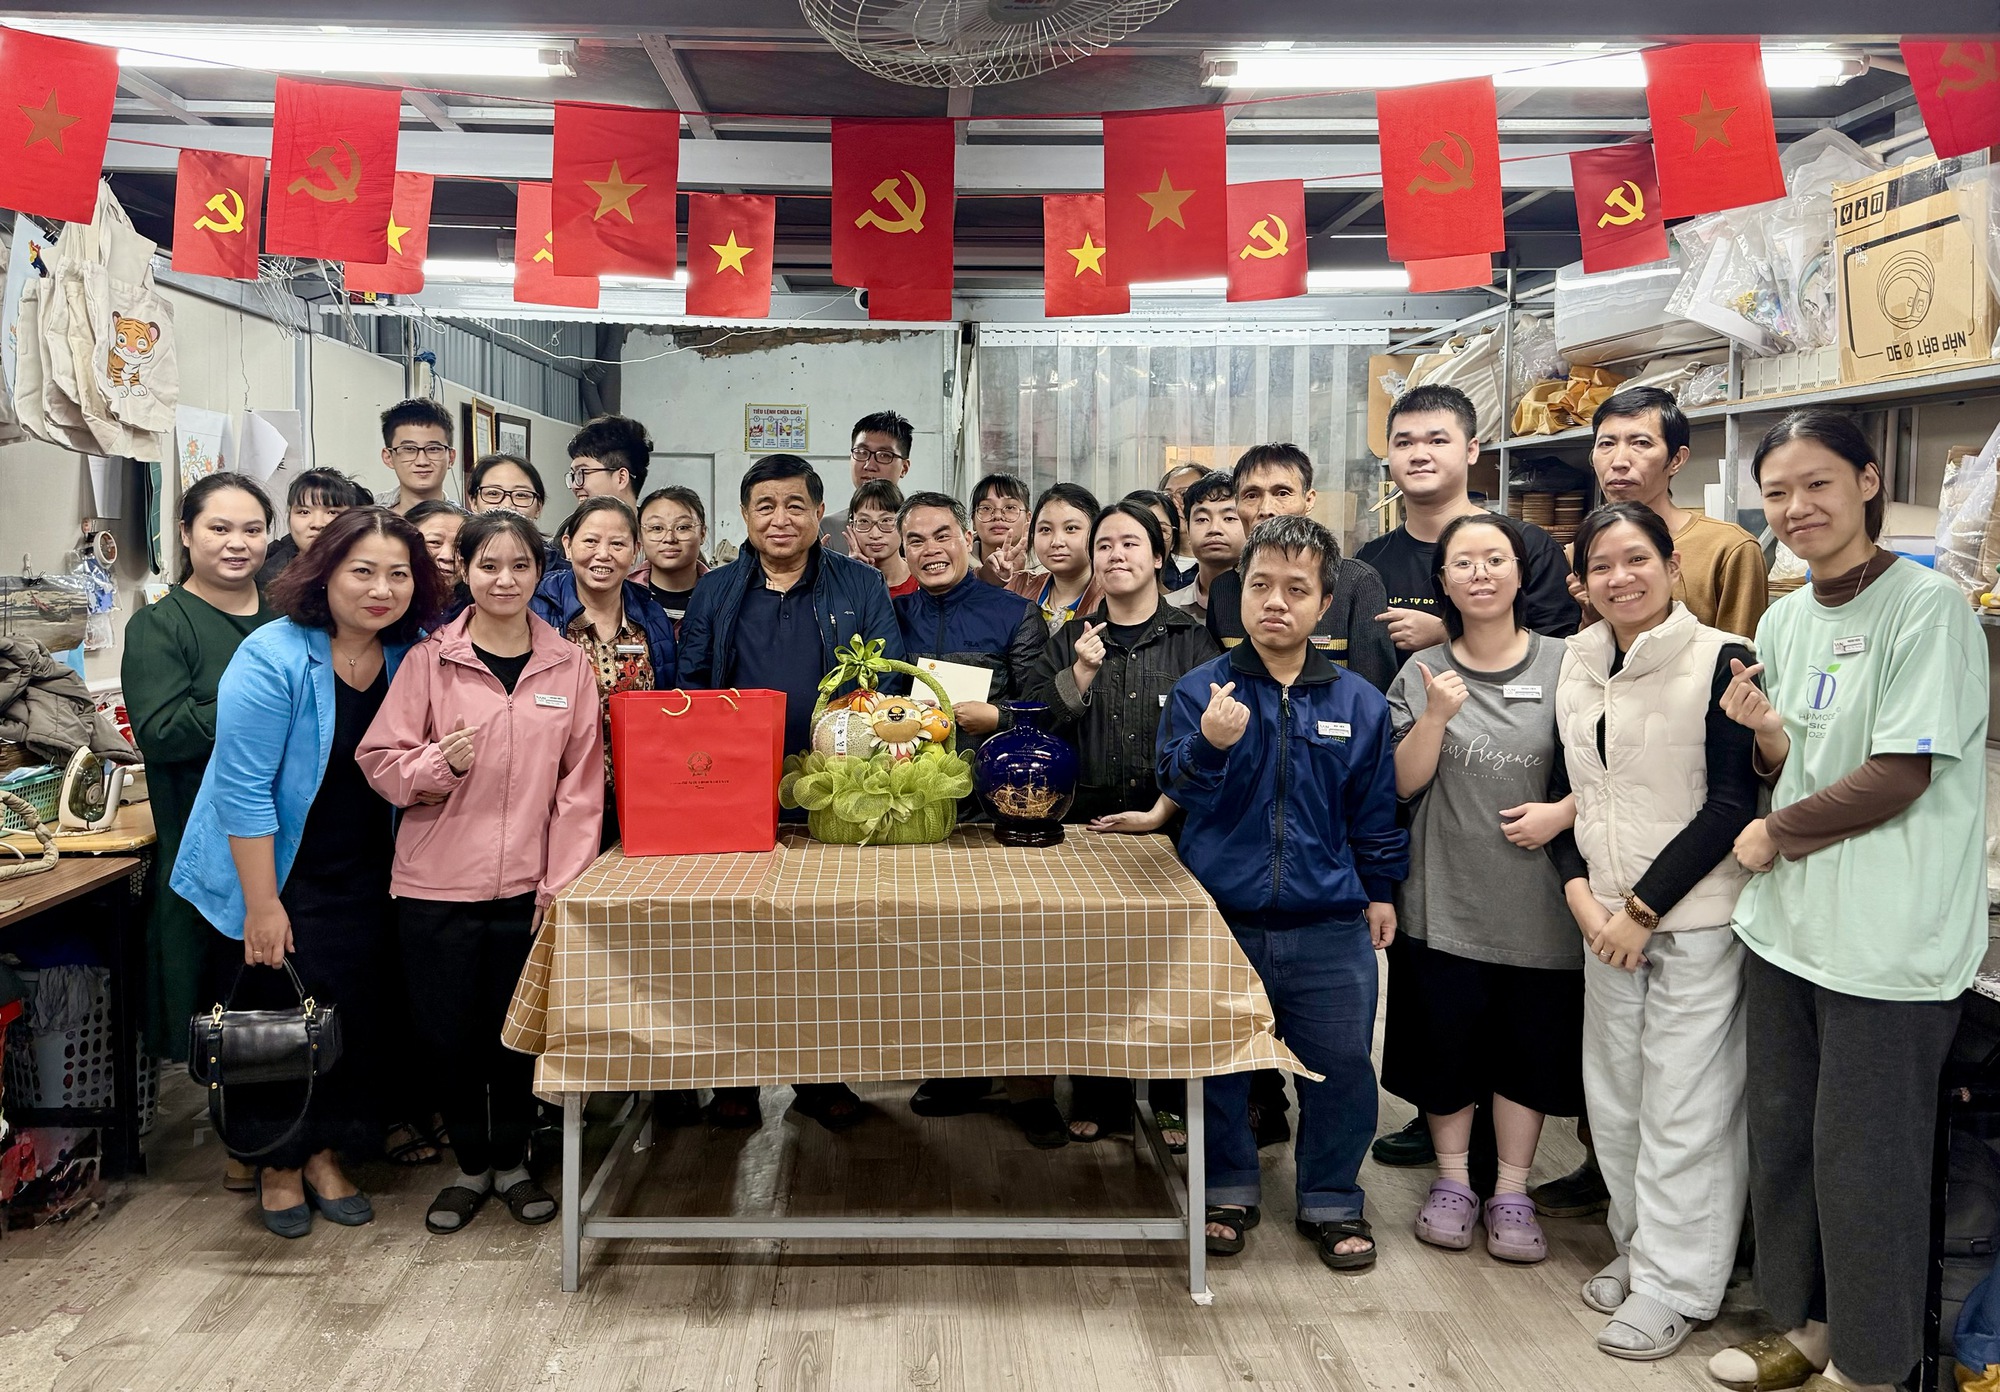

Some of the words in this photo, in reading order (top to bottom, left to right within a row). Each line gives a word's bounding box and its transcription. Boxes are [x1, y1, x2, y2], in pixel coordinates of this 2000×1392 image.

[1886, 345, 1903, 361] 90
[1917, 335, 1940, 358] BẬT
[1462, 733, 1545, 771] Presence
